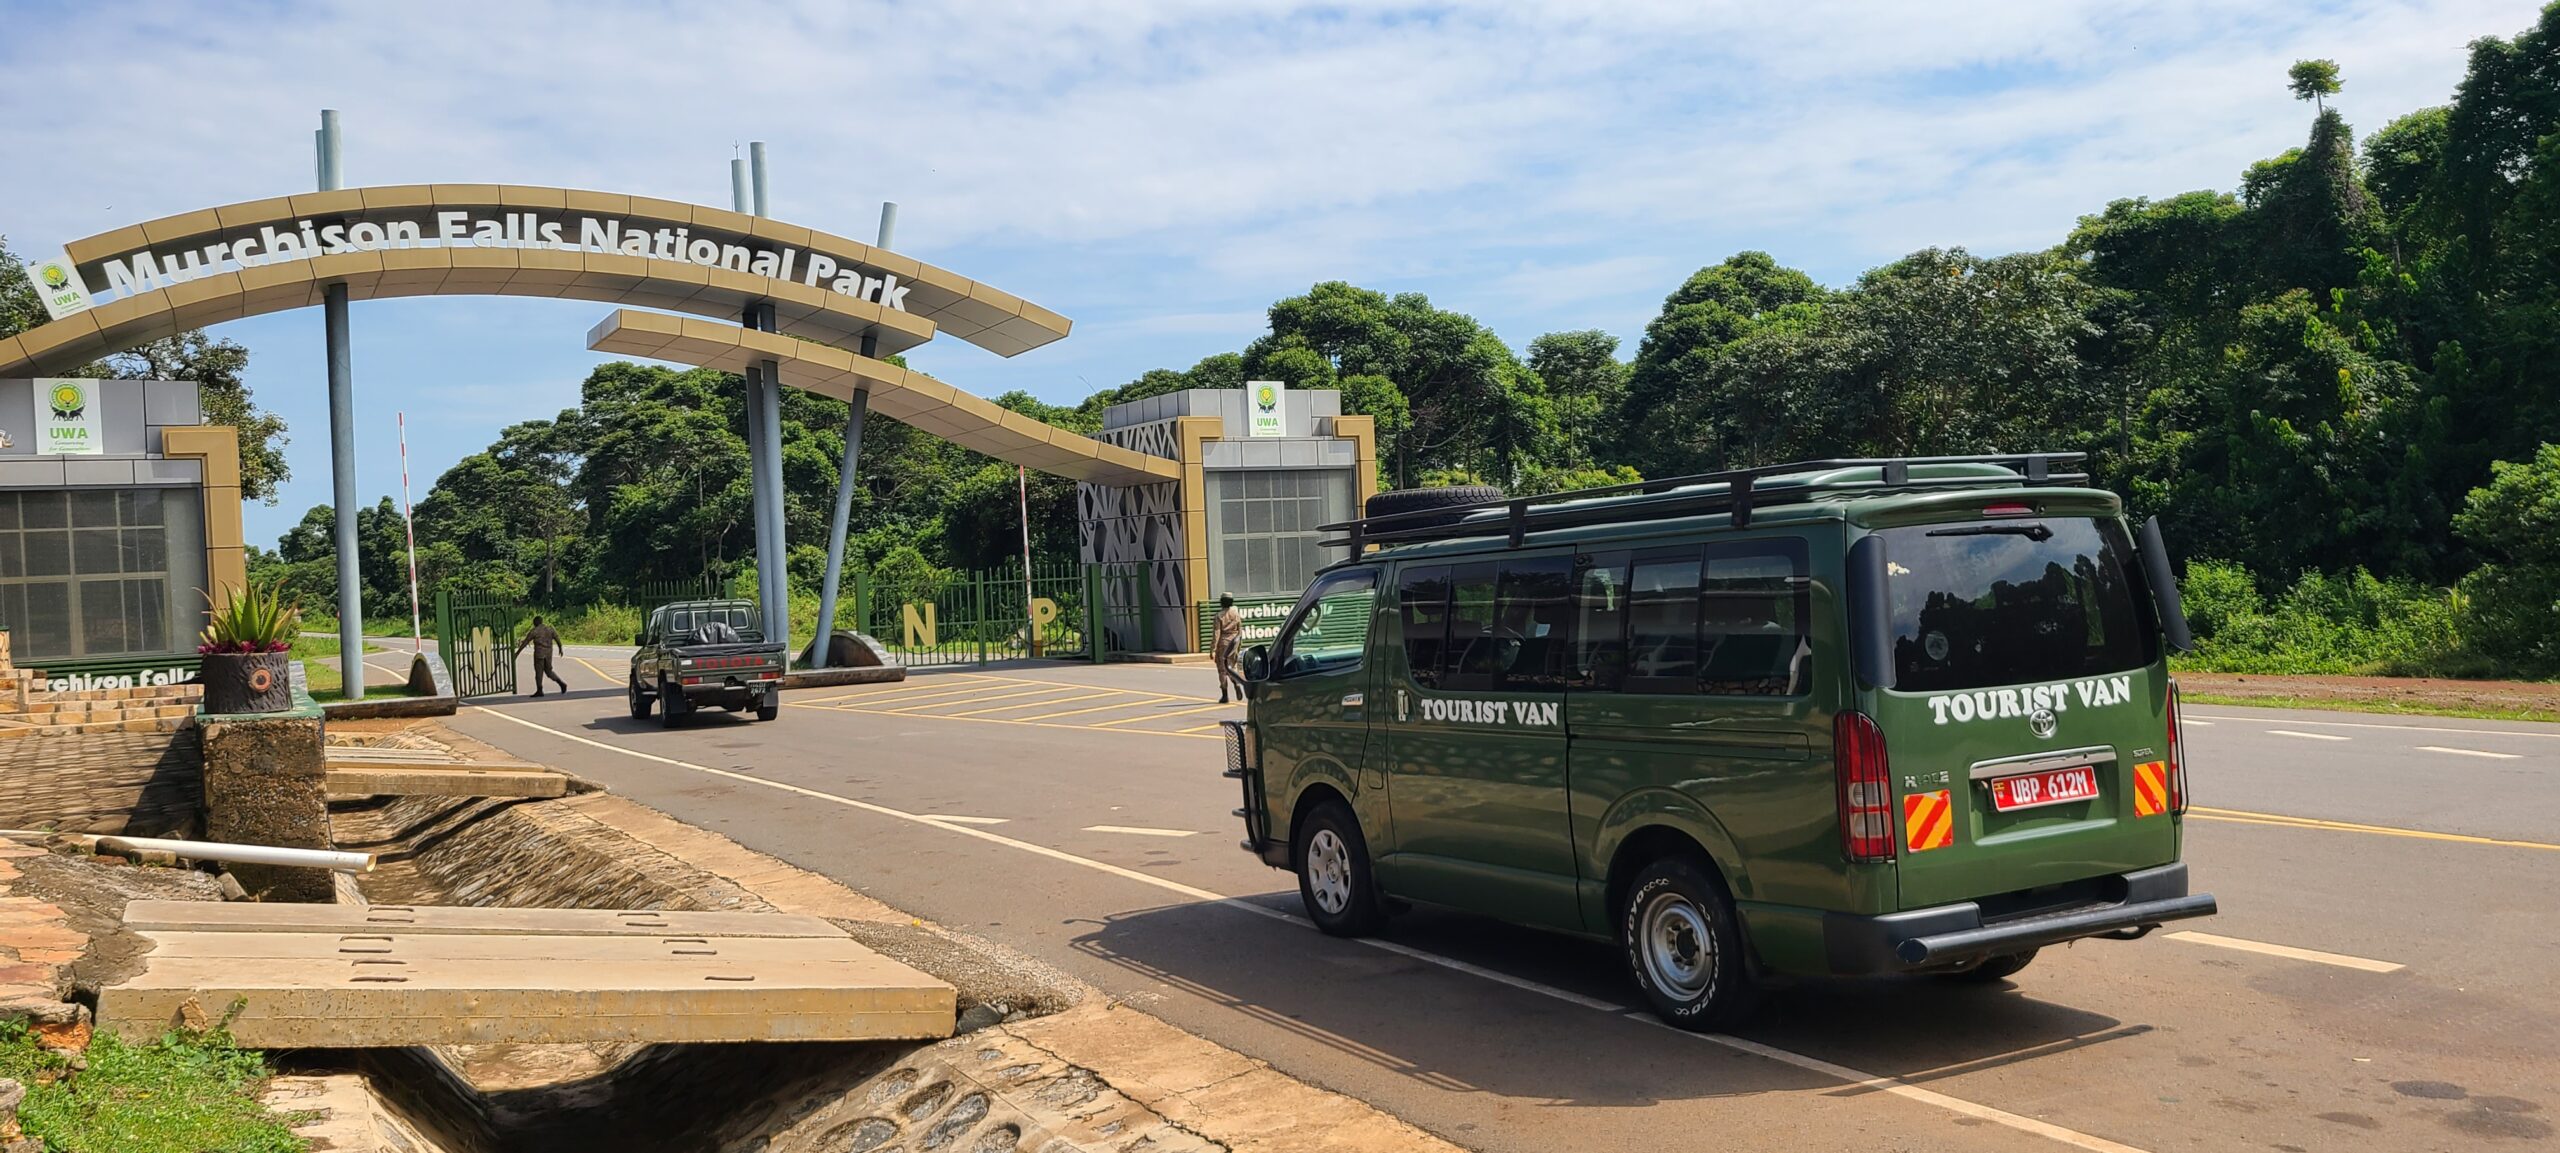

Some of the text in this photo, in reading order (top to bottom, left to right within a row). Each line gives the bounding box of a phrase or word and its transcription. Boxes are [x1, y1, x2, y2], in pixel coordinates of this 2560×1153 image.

[103, 211, 911, 313] Murchison Falls National Park
[53, 291, 81, 306] UWA
[49, 427, 89, 439] UWA
[1257, 417, 1278, 427] UWA
[1032, 598, 1057, 641] P
[1232, 602, 1296, 619] urchiso
[902, 602, 936, 648] N
[472, 626, 492, 676] M
[694, 656, 765, 671] TOYOTA
[46, 673, 133, 692] rchison
[1421, 699, 1559, 726] TOURIST VAN
[1928, 675, 2131, 725] TOURIST VAN
[2010, 770, 2090, 804] UBP 612M
